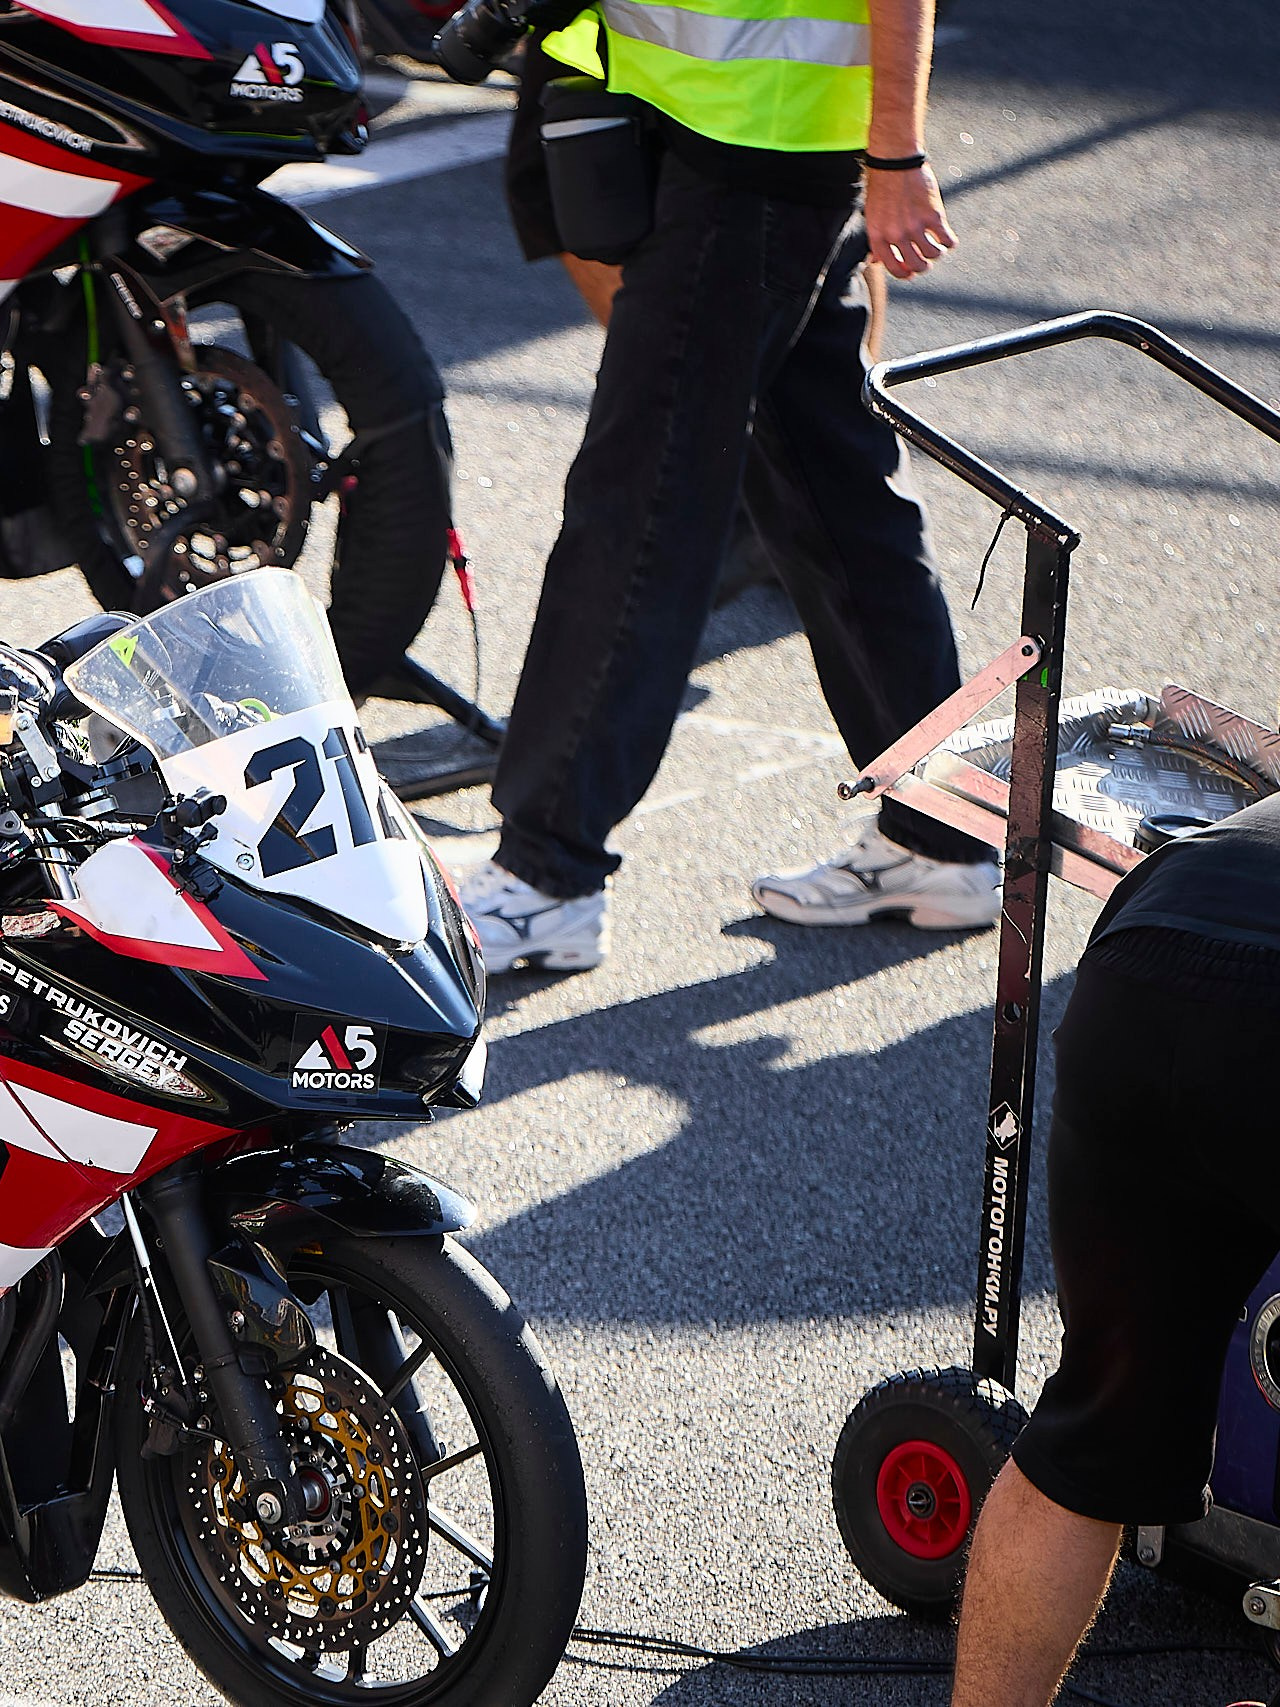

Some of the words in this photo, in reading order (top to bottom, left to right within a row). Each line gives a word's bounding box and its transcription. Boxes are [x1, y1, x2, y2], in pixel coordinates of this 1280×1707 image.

[229, 82, 305, 103] MOTORS
[63, 1018, 179, 1087] SERGEY
[292, 1071, 375, 1090] MOTORS
[982, 1155, 1010, 1339] МОТОГОНКИ.РУ
